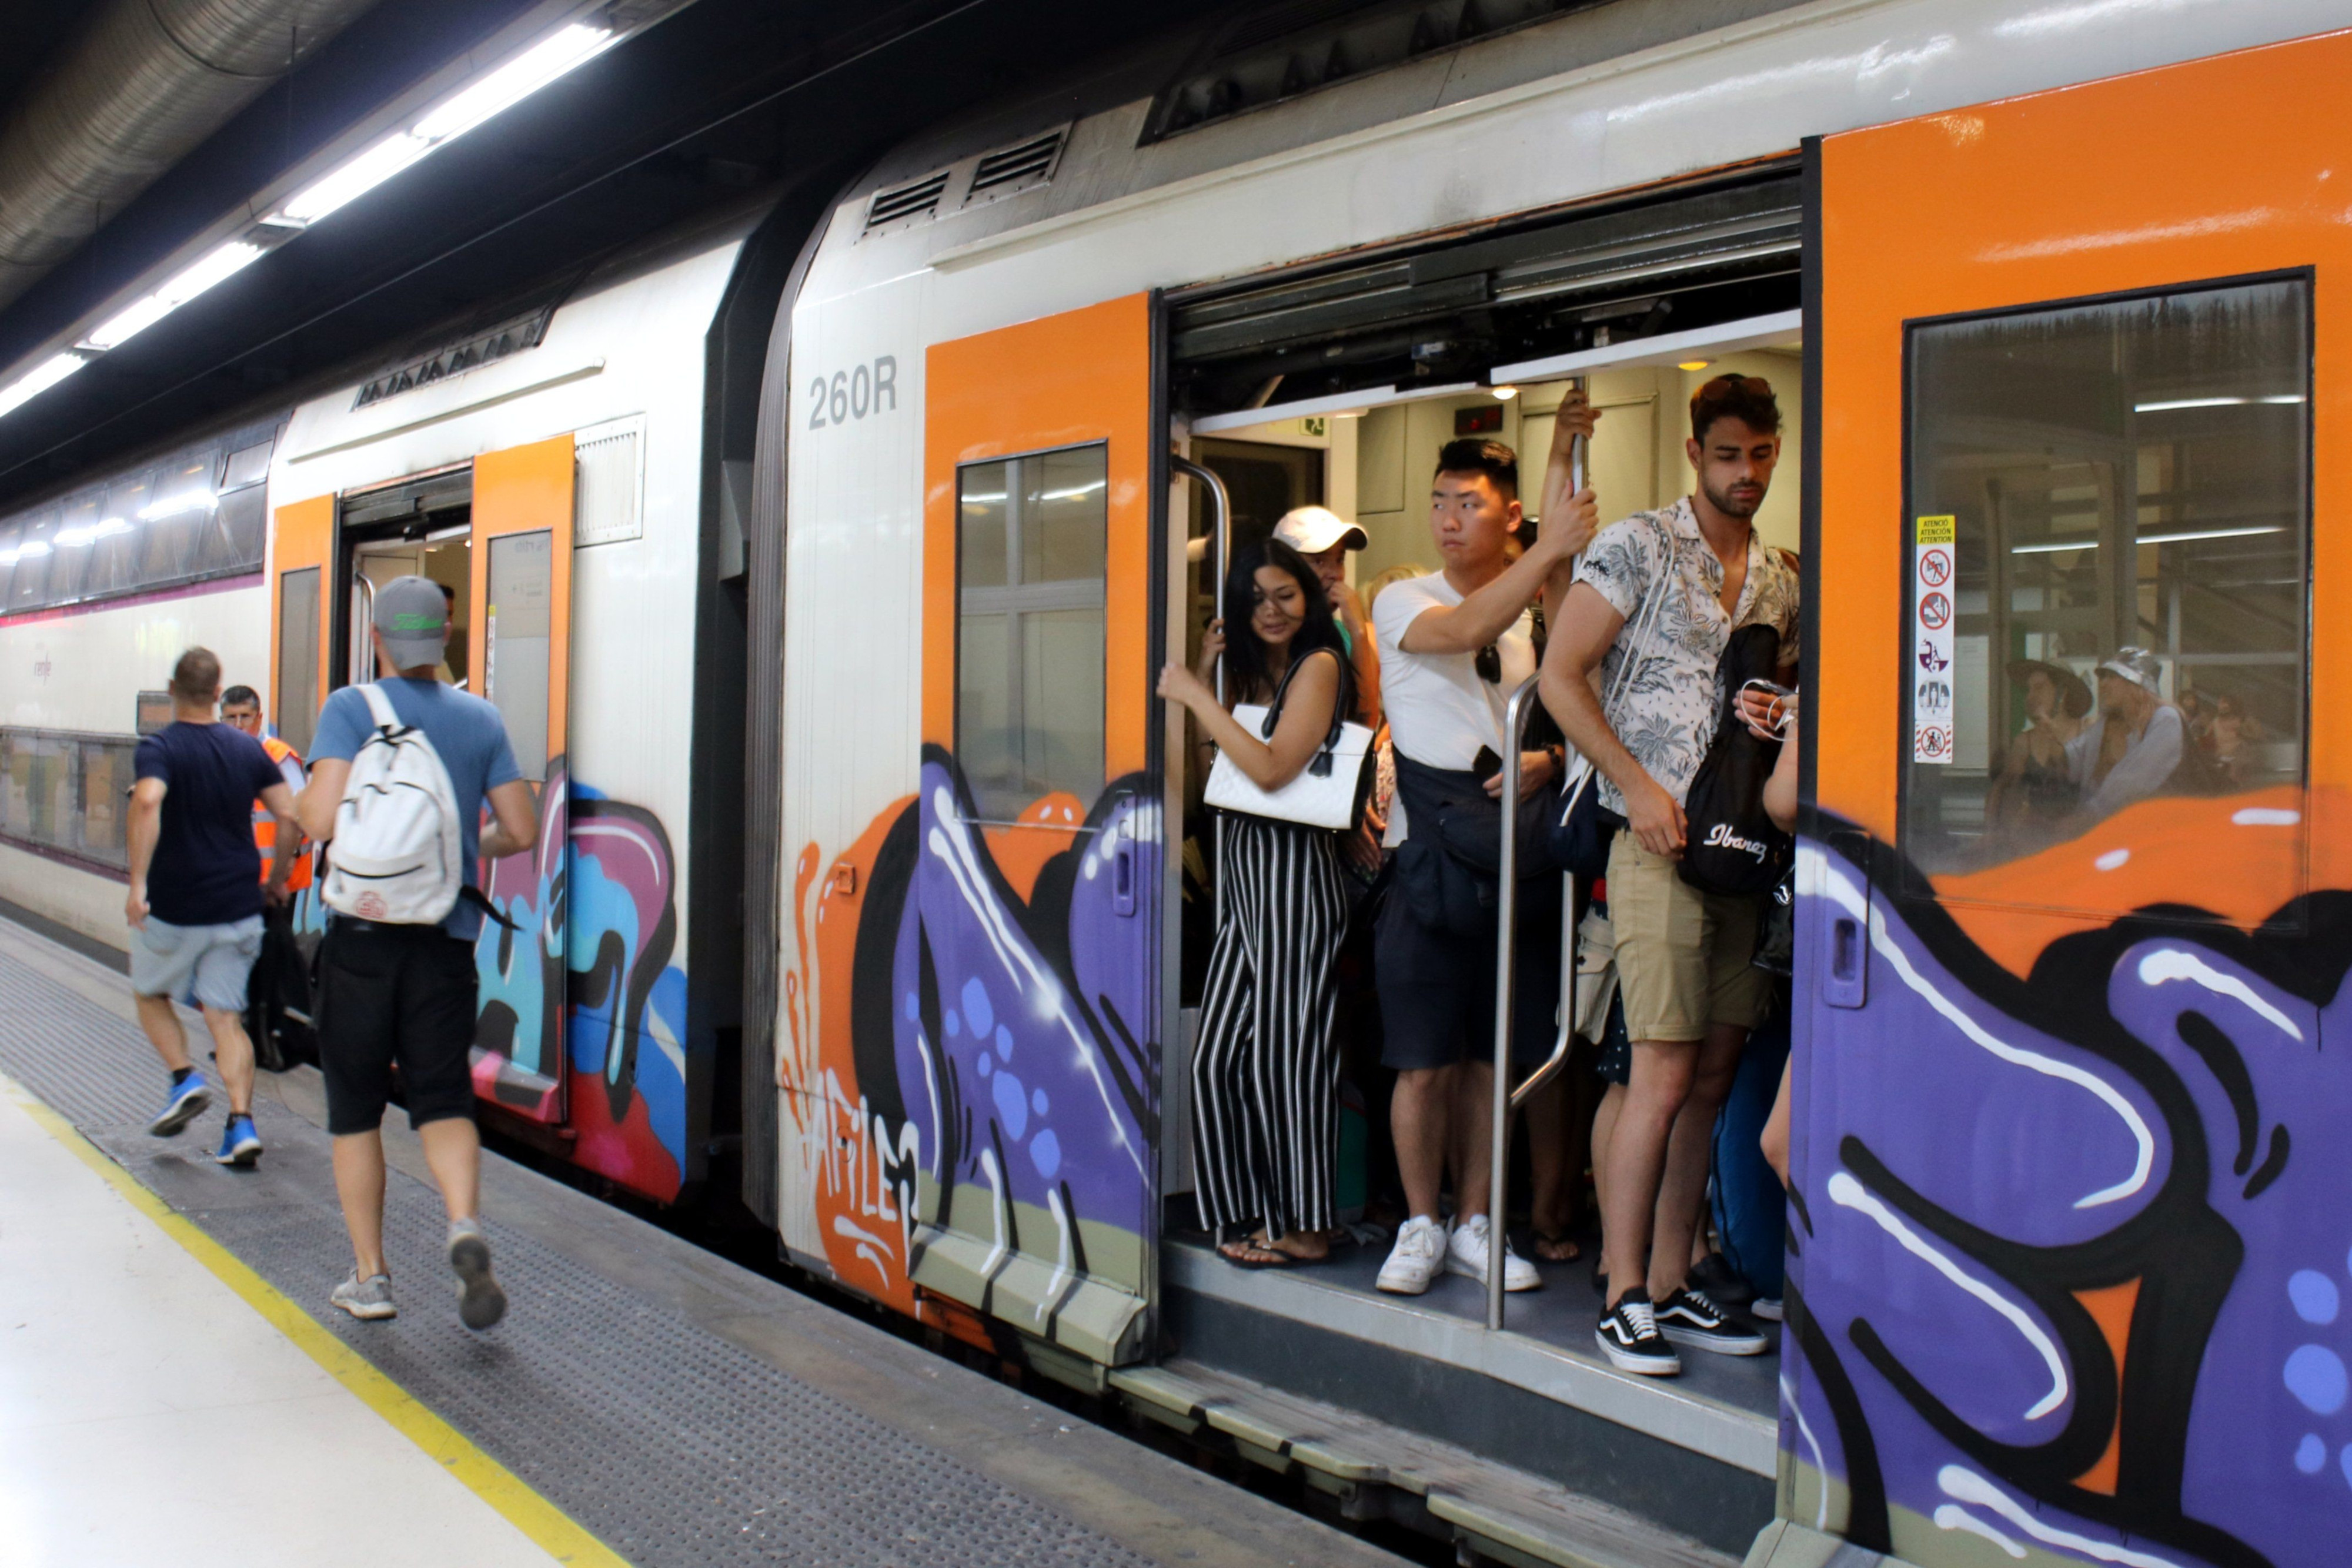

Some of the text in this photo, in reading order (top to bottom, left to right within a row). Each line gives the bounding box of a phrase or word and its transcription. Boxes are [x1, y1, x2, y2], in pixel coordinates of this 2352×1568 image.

[809, 355, 897, 430] 260R
[1923, 518, 1948, 527] ATENCIÓ
[1920, 527, 1951, 536] ATENCIÓN
[1919, 536, 1952, 544] ATTENTION
[1703, 823, 1768, 864] Ibanez
